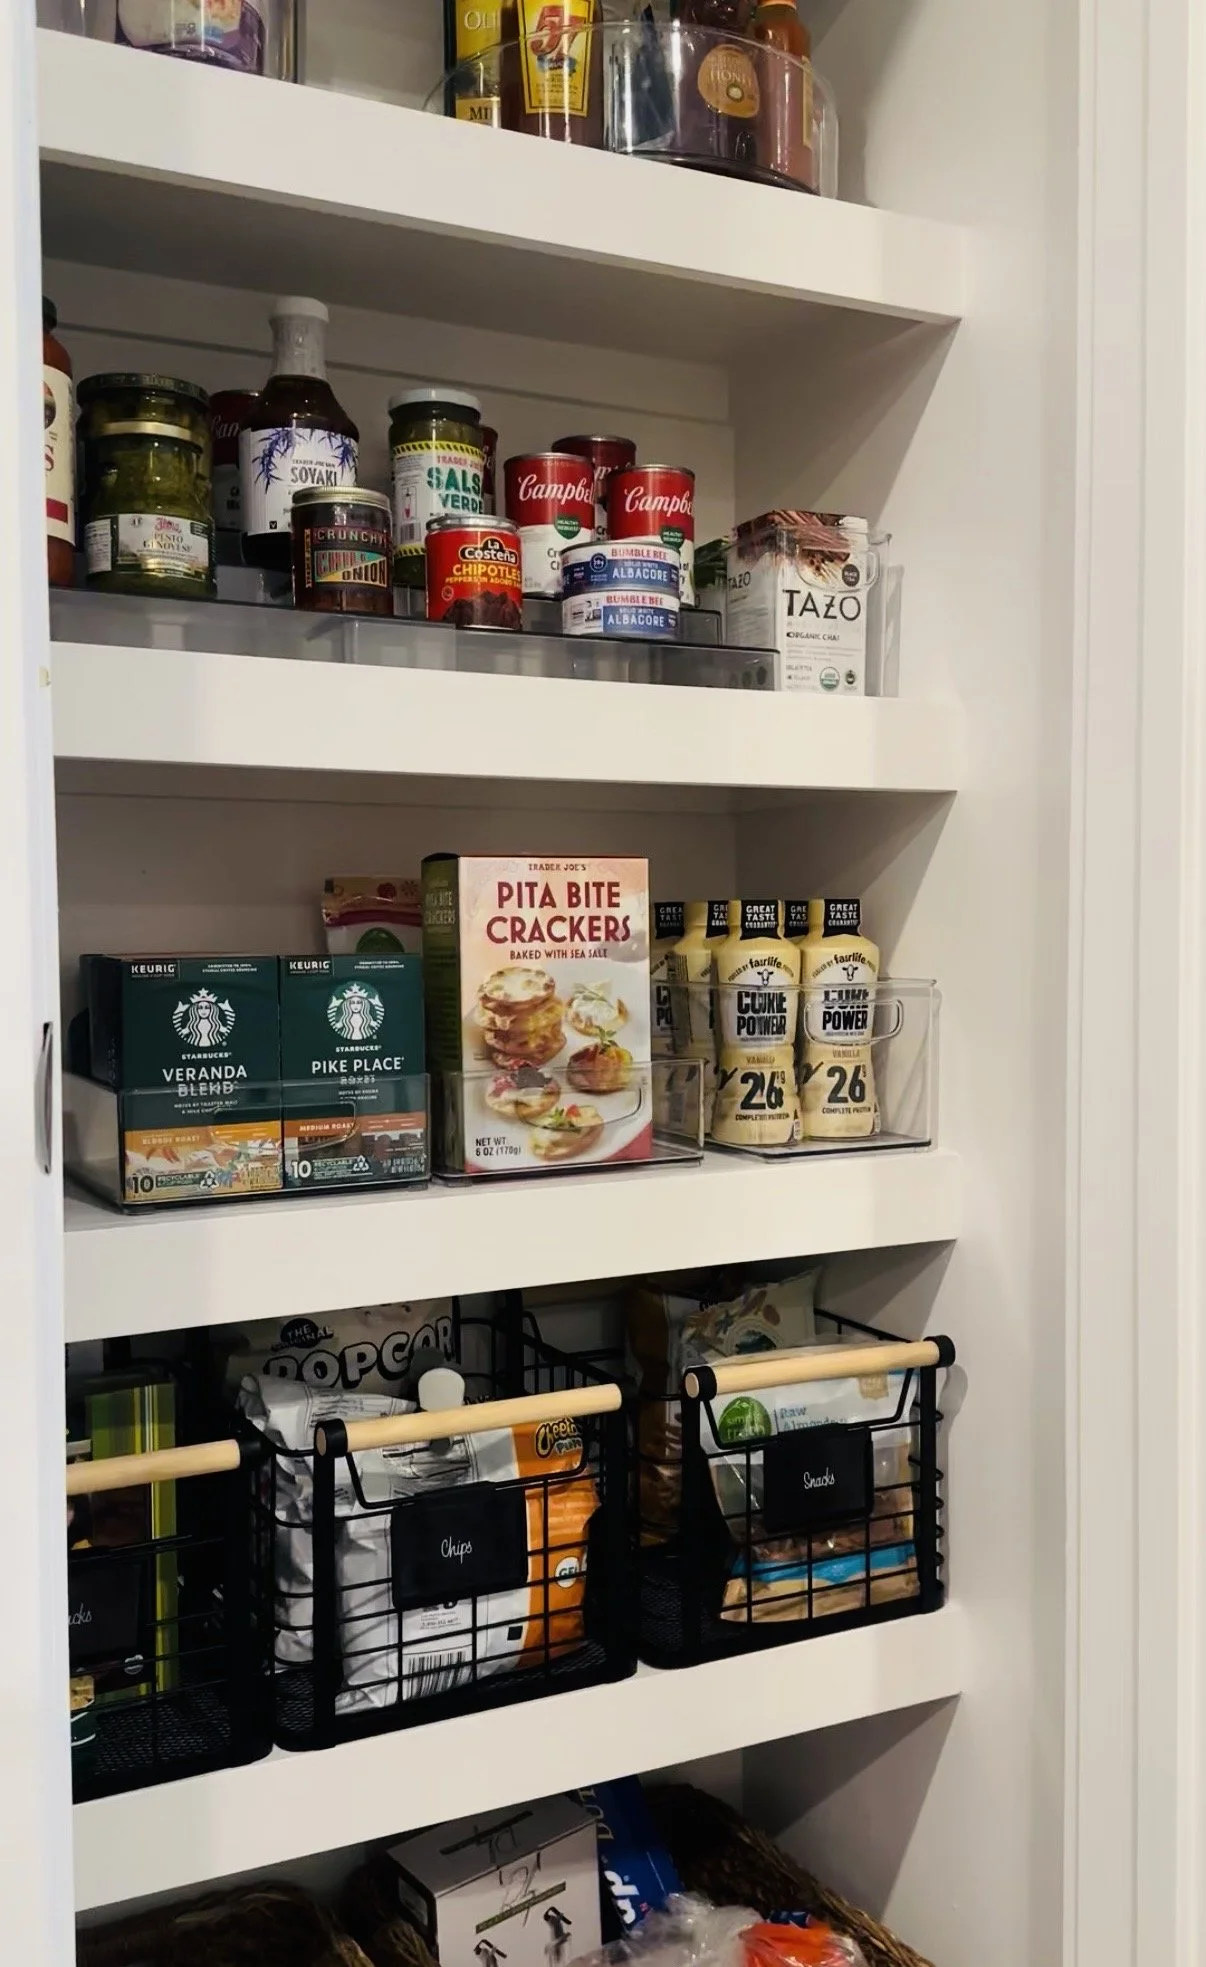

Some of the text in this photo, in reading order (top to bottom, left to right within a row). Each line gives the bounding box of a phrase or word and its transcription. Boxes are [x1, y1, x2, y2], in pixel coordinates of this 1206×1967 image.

[291, 466, 337, 487] SOYAKI
[427, 466, 481, 496] SALS
[487, 540, 500, 549] La
[464, 547, 516, 563] Costeña
[611, 548, 667, 560] BUMBLE BEE
[342, 560, 386, 585] ONION
[453, 564, 521, 581] CHIPOTLES
[612, 567, 668, 581] ALBACORE
[606, 595, 664, 606] BUMBLE BEE
[782, 588, 861, 621] TAZO
[608, 614, 665, 627] ALBACORE
[529, 863, 586, 871] TRADER JOE'S
[497, 881, 620, 909] PITA BITE
[746, 905, 775, 914] GREAT
[829, 903, 858, 912] GREAT
[746, 913, 775, 921] TASTE
[830, 911, 858, 919] TASTE
[486, 915, 631, 944] CRACKERS
[510, 949, 608, 960] BAKED WITH SEA SALT
[834, 952, 866, 964] fairlife
[131, 964, 175, 974] KEURIG
[289, 961, 330, 970] KEURIG
[749, 956, 782, 969] fairlife
[822, 1010, 868, 1031] POWER
[832, 1049, 860, 1058] VANILLA
[311, 1057, 402, 1074] PIKE PLACE
[162, 1065, 248, 1082] VERANDA
[299, 1122, 354, 1132] MEDIUM ROAST
[476, 1137, 491, 1146] NET
[476, 1148, 481, 1156] 6
[483, 1147, 494, 1156] OZ
[291, 1160, 312, 1178] 10
[132, 1173, 154, 1193] 10
[286, 1323, 312, 1339] THE
[803, 1467, 835, 1490] Snacks
[441, 1536, 473, 1564] Chips
